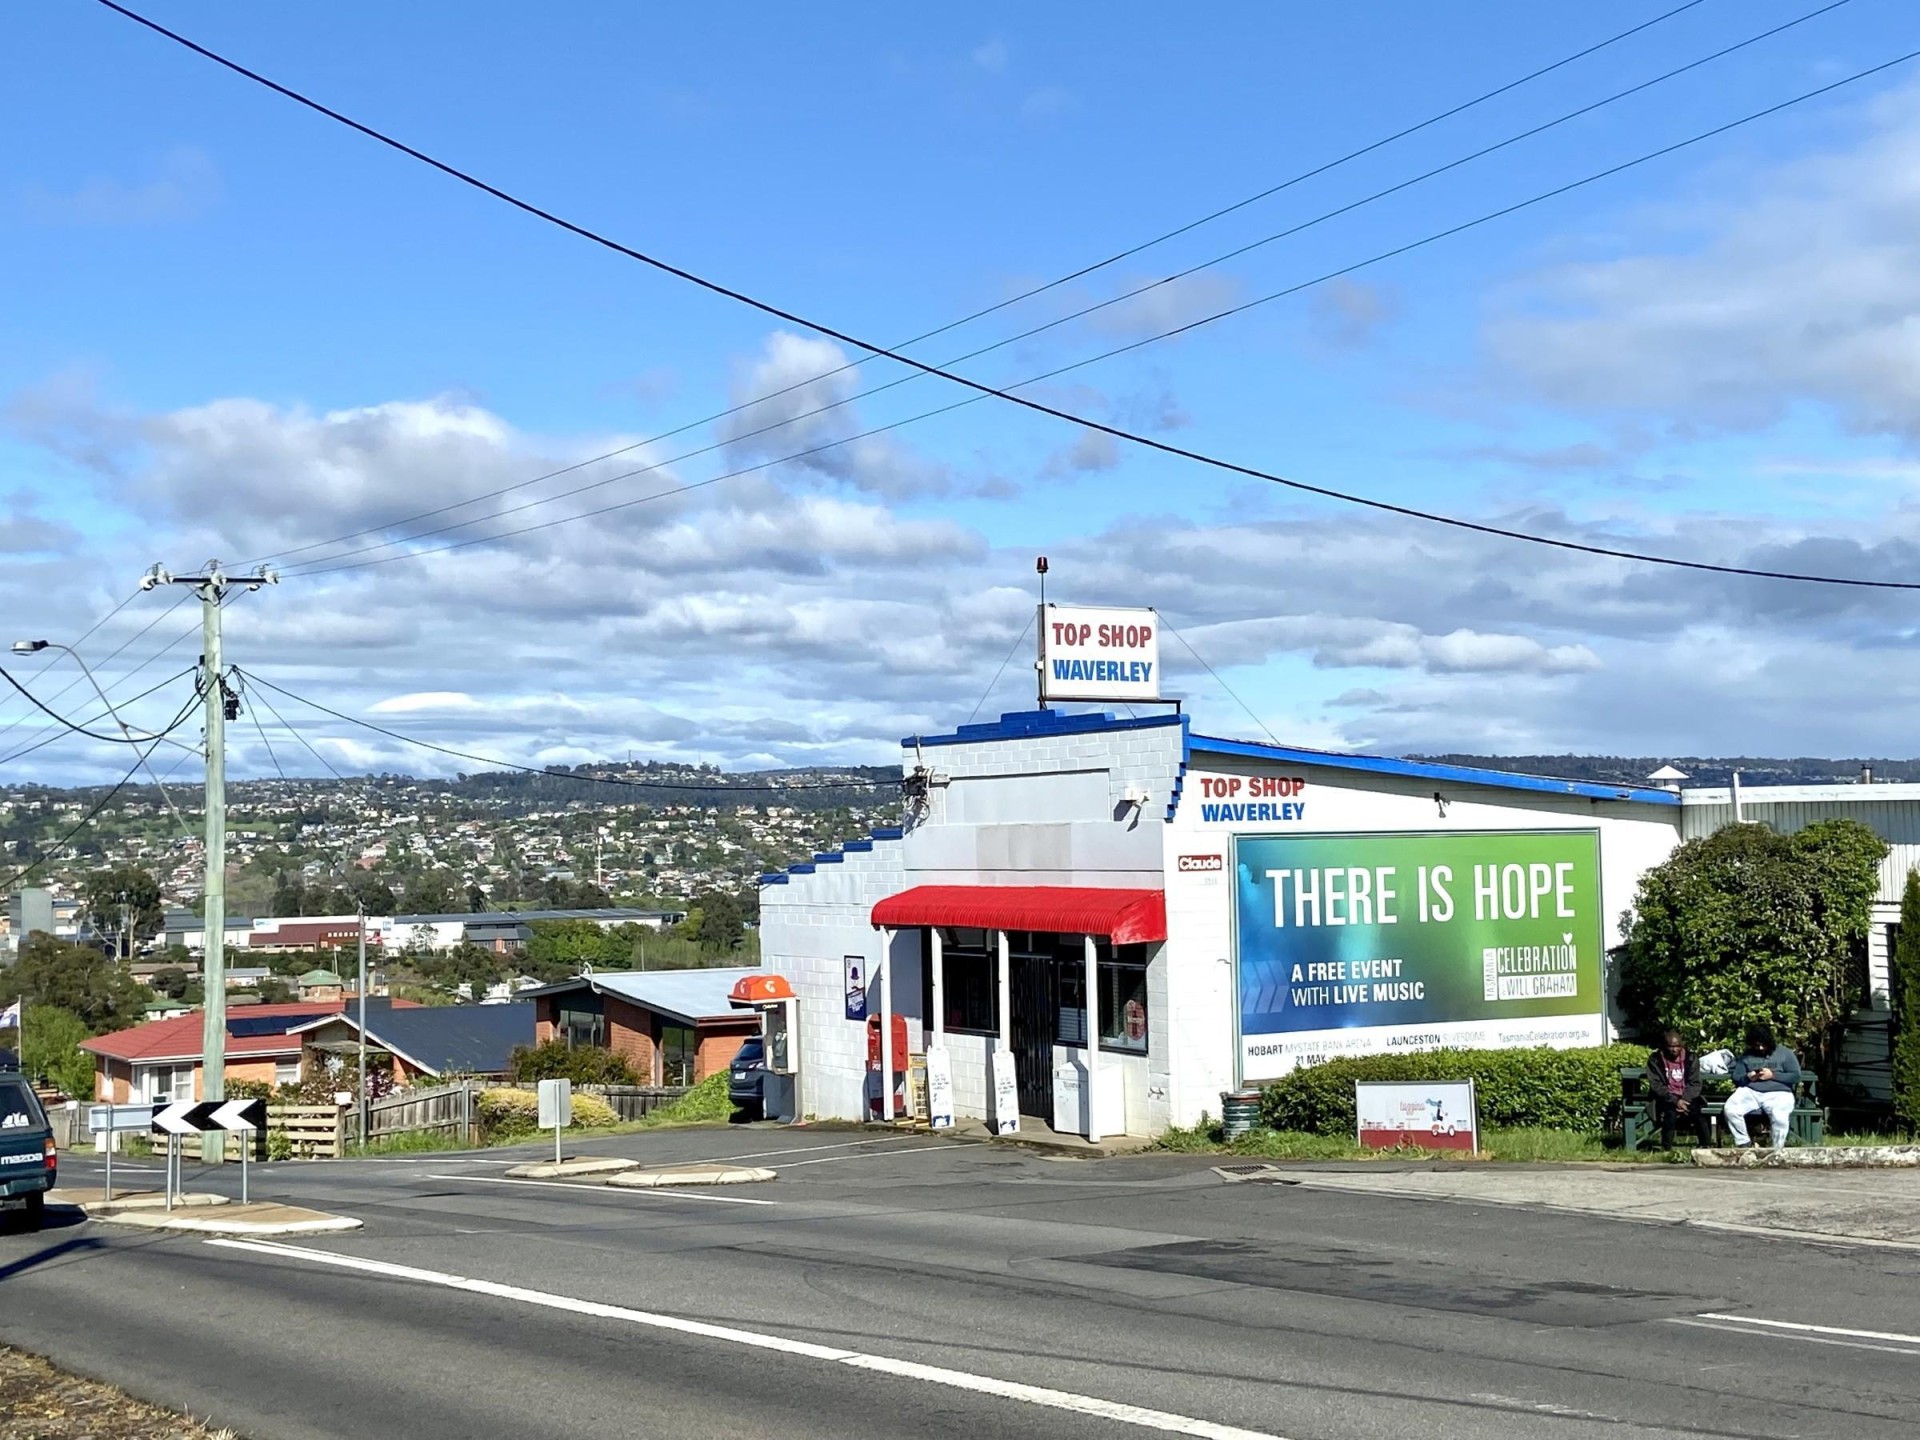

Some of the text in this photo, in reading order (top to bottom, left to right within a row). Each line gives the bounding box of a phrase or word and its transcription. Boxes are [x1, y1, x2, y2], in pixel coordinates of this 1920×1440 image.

[1052, 623, 1152, 648] TOP SHOP
[1053, 659, 1152, 682] WAVERLEY
[1200, 776, 1305, 798] TOP SHOP
[1201, 802, 1305, 821] WAVERLEY
[1179, 856, 1221, 871] Claude
[1265, 862, 1576, 928] THERE IS HOPE
[1497, 944, 1577, 974] CELEBRATION
[1291, 959, 1403, 983] A FREE EVENT
[1291, 981, 1425, 1007] WITH LIVE MUSIC
[1507, 977, 1529, 996] WILL
[1532, 974, 1576, 996] GRAHAM
[1386, 1031, 1486, 1046] LAUNCESTON SVERDOME
[1247, 1044, 1284, 1056] HOBART
[1, 1153, 43, 1165] mazda
